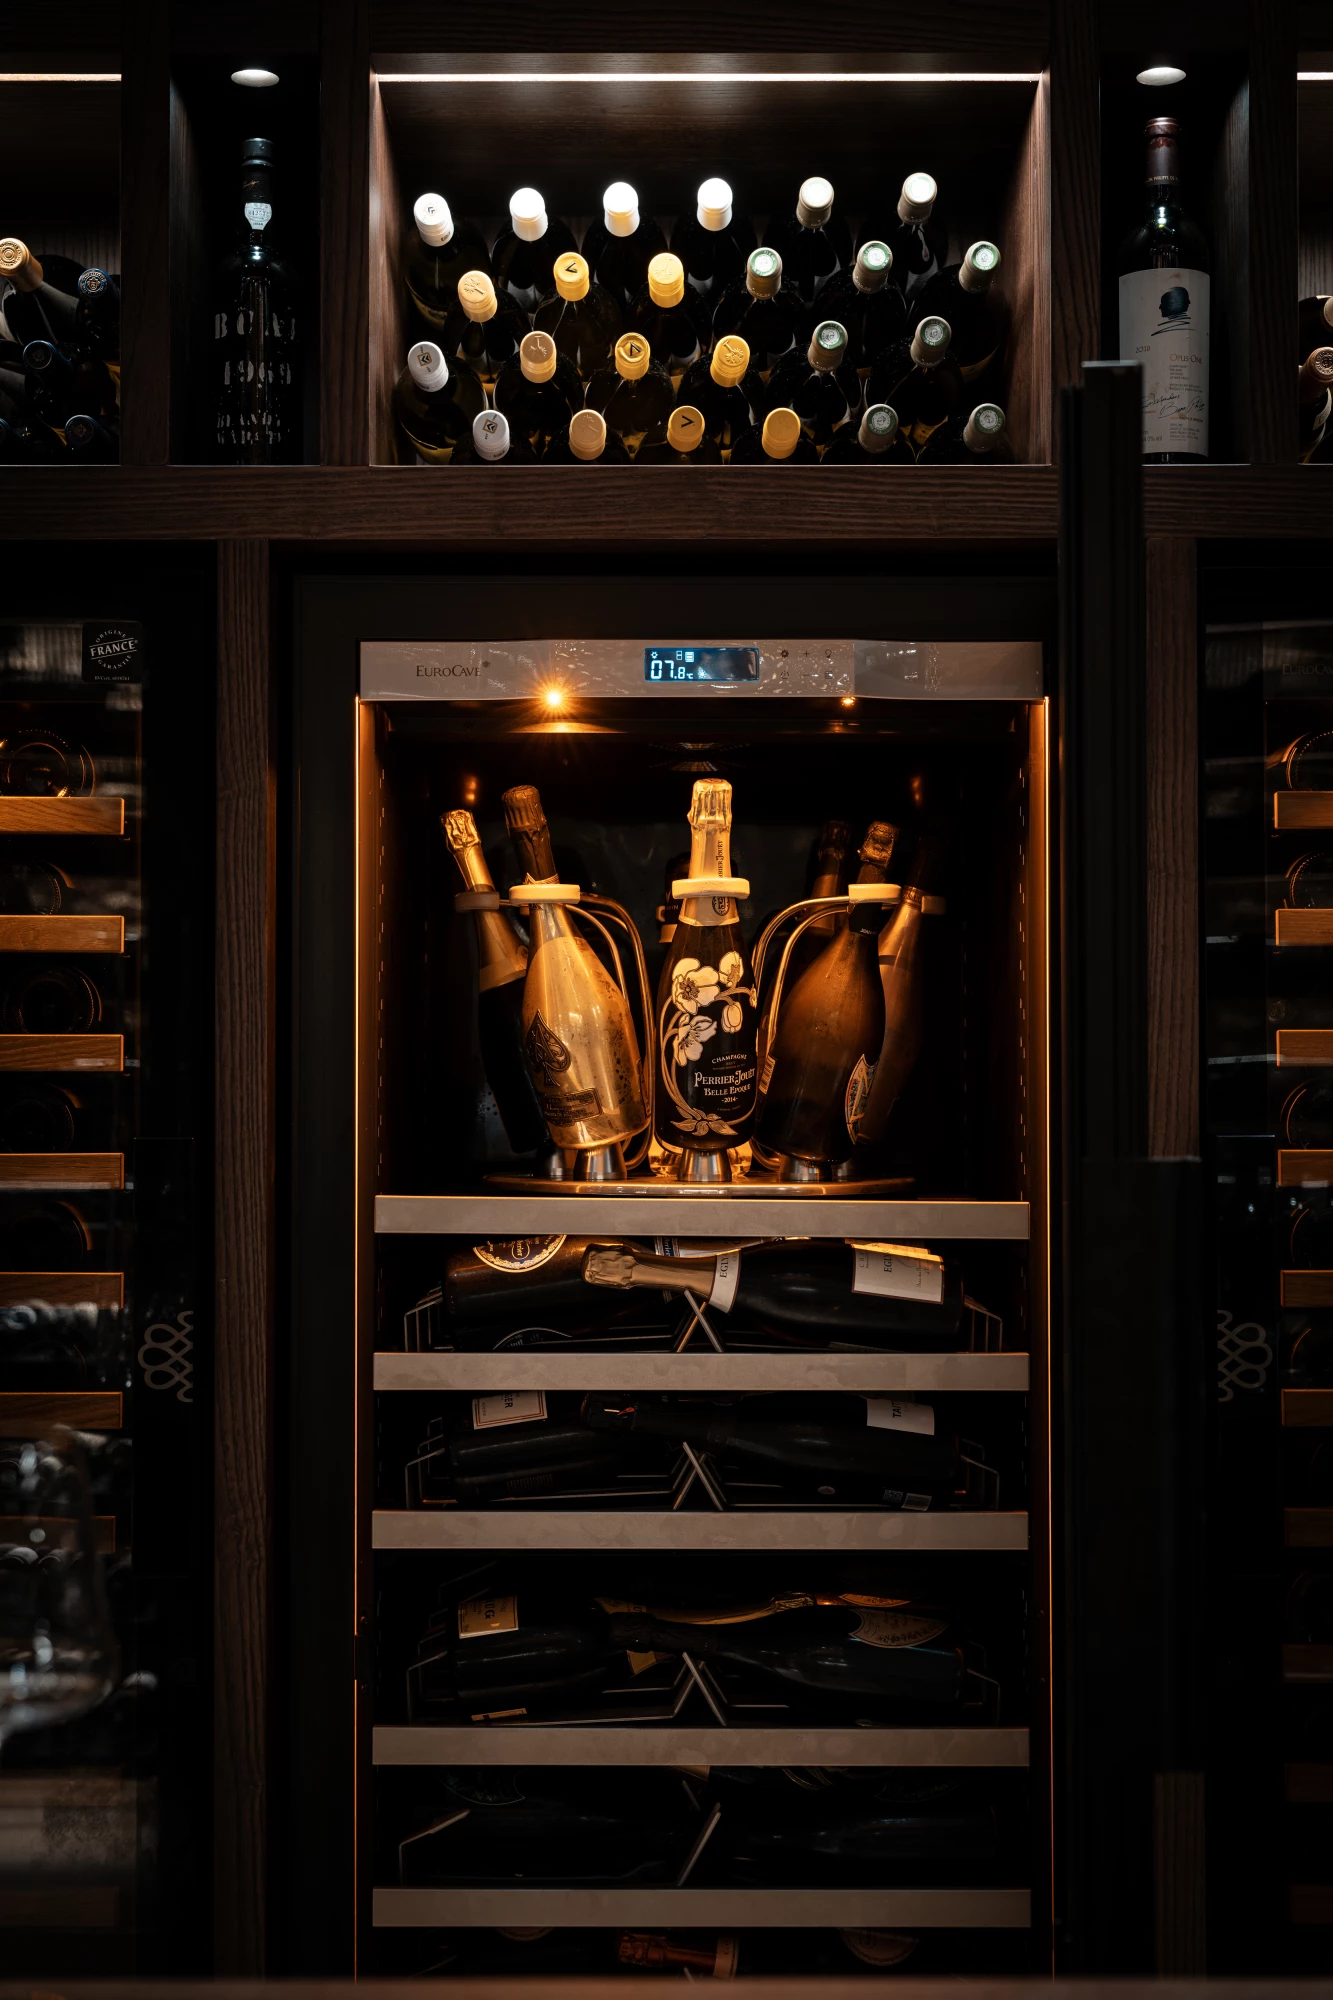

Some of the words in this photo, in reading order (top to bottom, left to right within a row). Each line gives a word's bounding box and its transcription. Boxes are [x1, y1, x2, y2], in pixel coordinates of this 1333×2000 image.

[1135, 345, 1151, 354] 2018
[95, 629, 127, 643] ORIGINE
[97, 654, 132, 670] GARANTIE
[711, 1053, 748, 1064] CHAMPAGNE
[703, 1087, 728, 1096] BELLE
